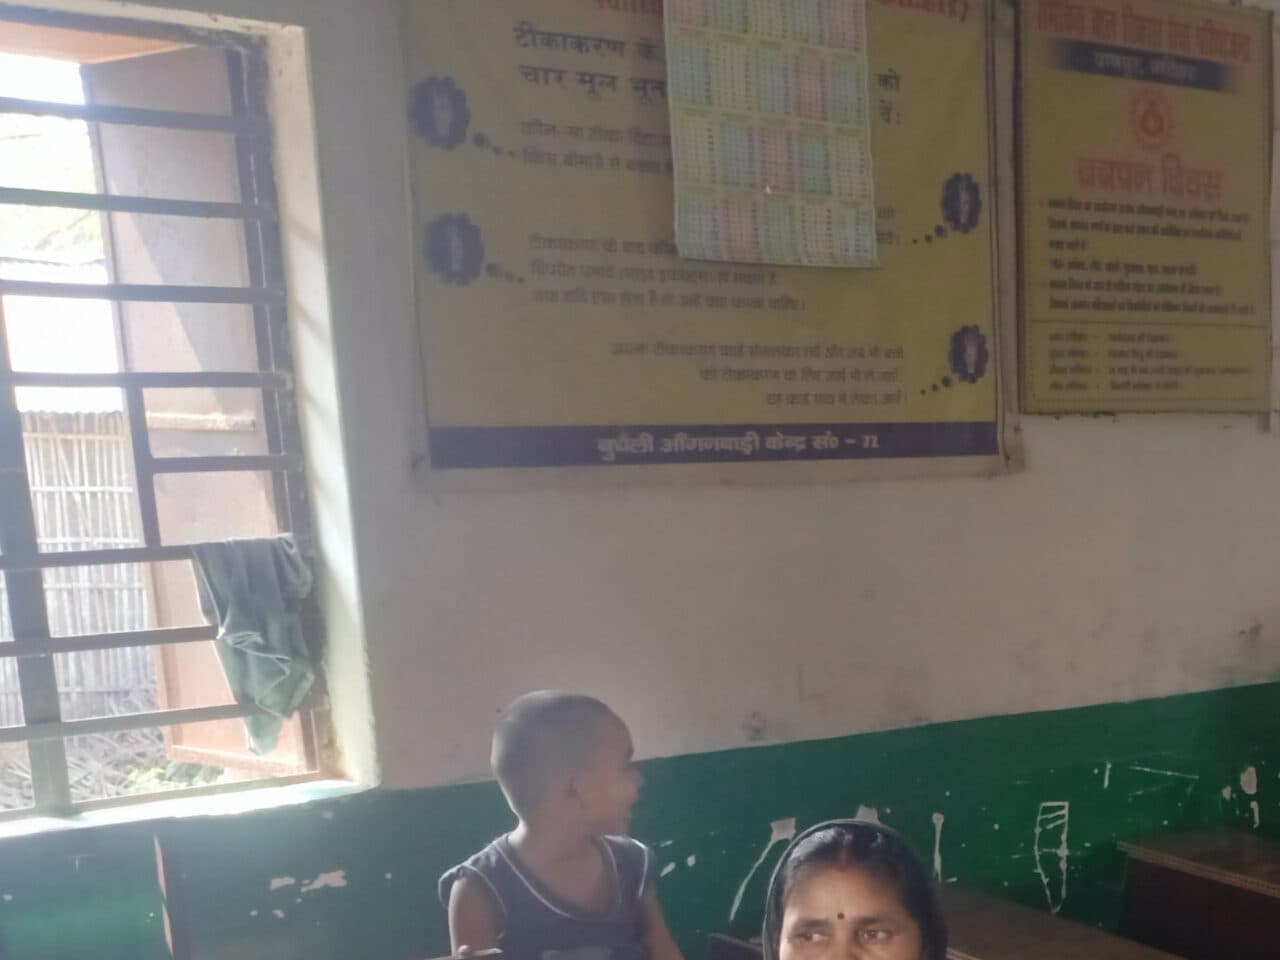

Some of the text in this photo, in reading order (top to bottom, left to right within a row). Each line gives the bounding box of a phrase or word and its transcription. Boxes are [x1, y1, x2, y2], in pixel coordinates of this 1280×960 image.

[512, 20, 625, 57] टीकाकरण
[518, 65, 568, 89] चार
[576, 71, 619, 100] मूल
[874, 67, 901, 93] को
